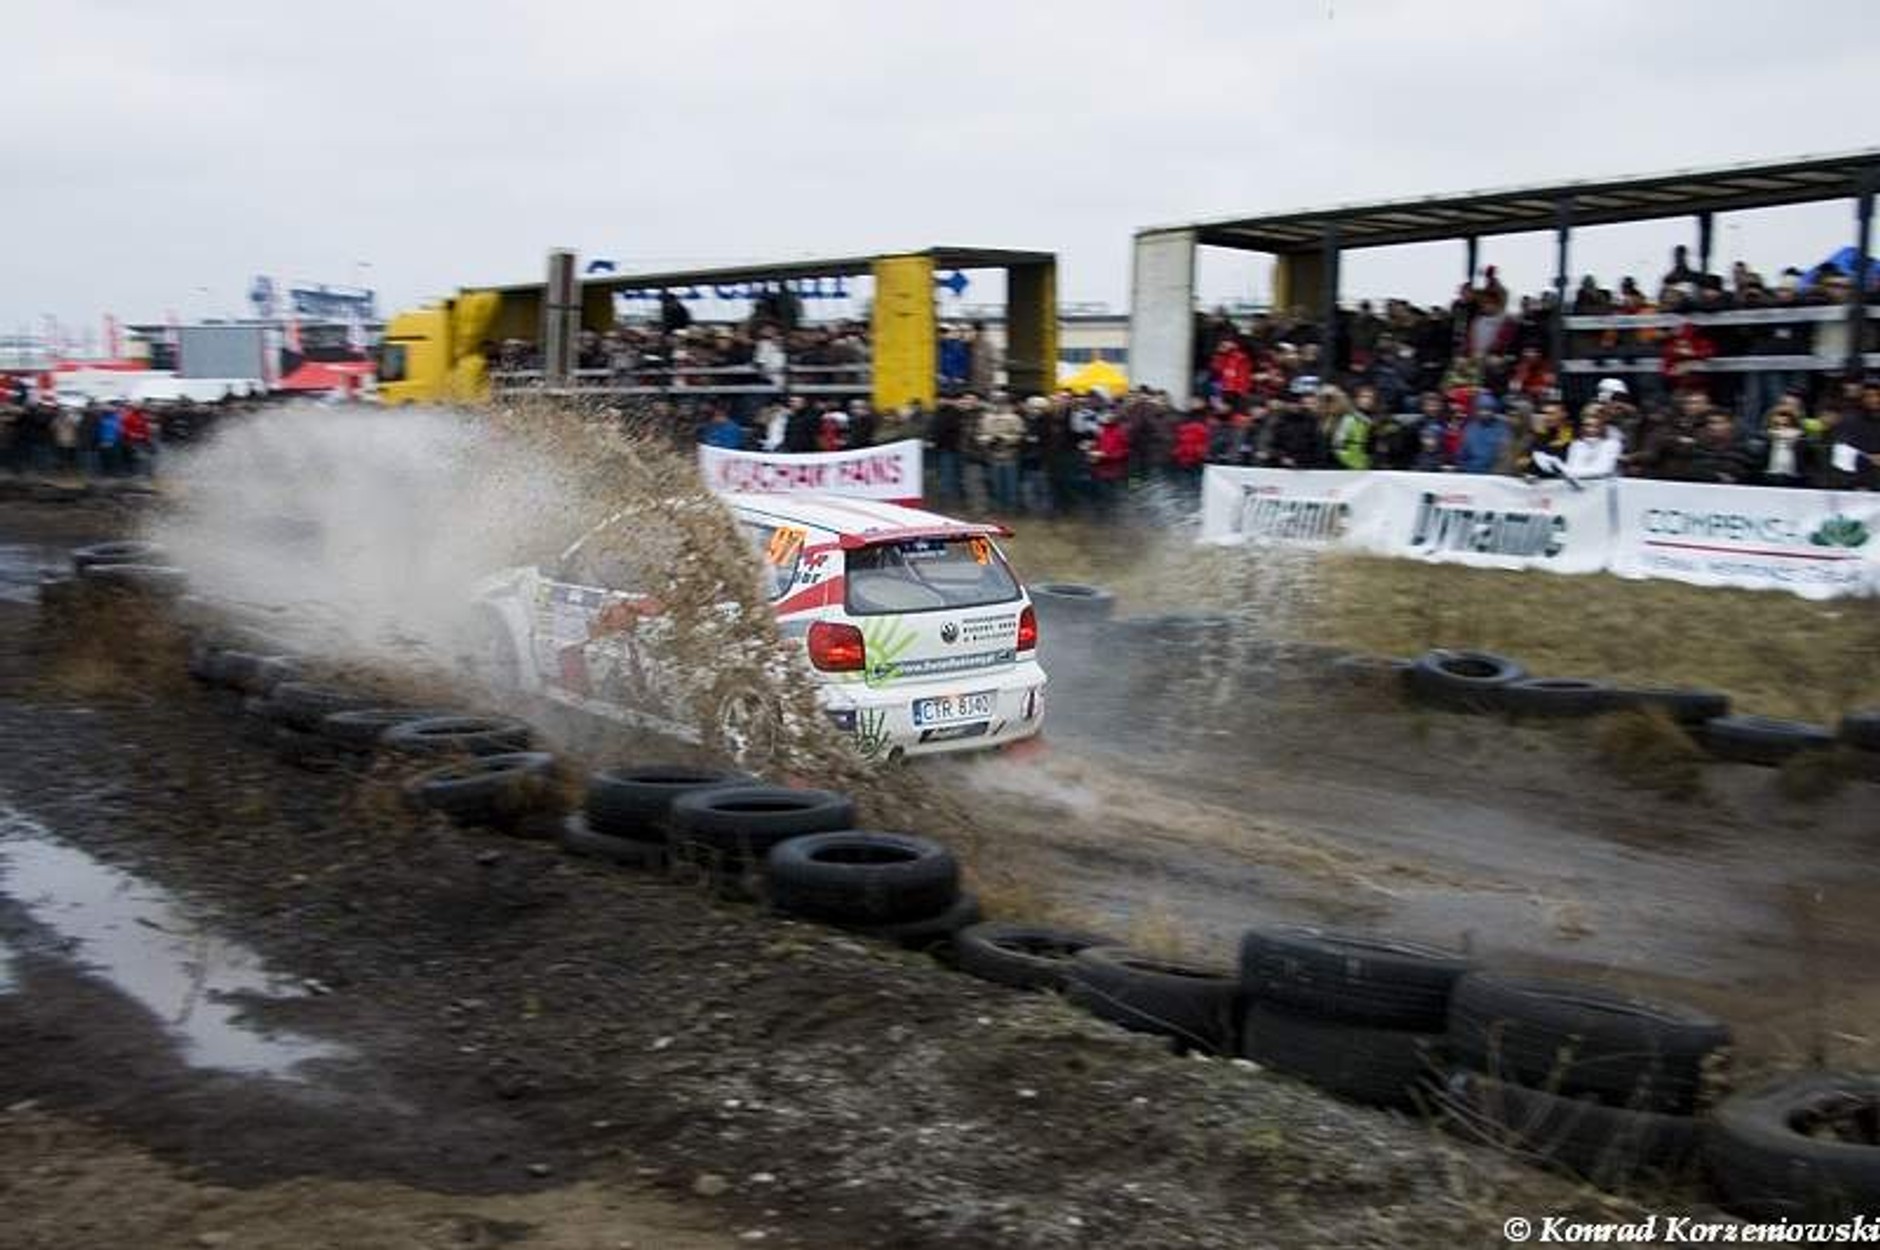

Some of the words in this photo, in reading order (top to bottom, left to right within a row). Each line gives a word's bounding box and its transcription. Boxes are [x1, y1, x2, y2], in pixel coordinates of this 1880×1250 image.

[1233, 484, 1351, 539] namic
[1412, 492, 1566, 557] Dynamic
[923, 700, 954, 720] CTR
